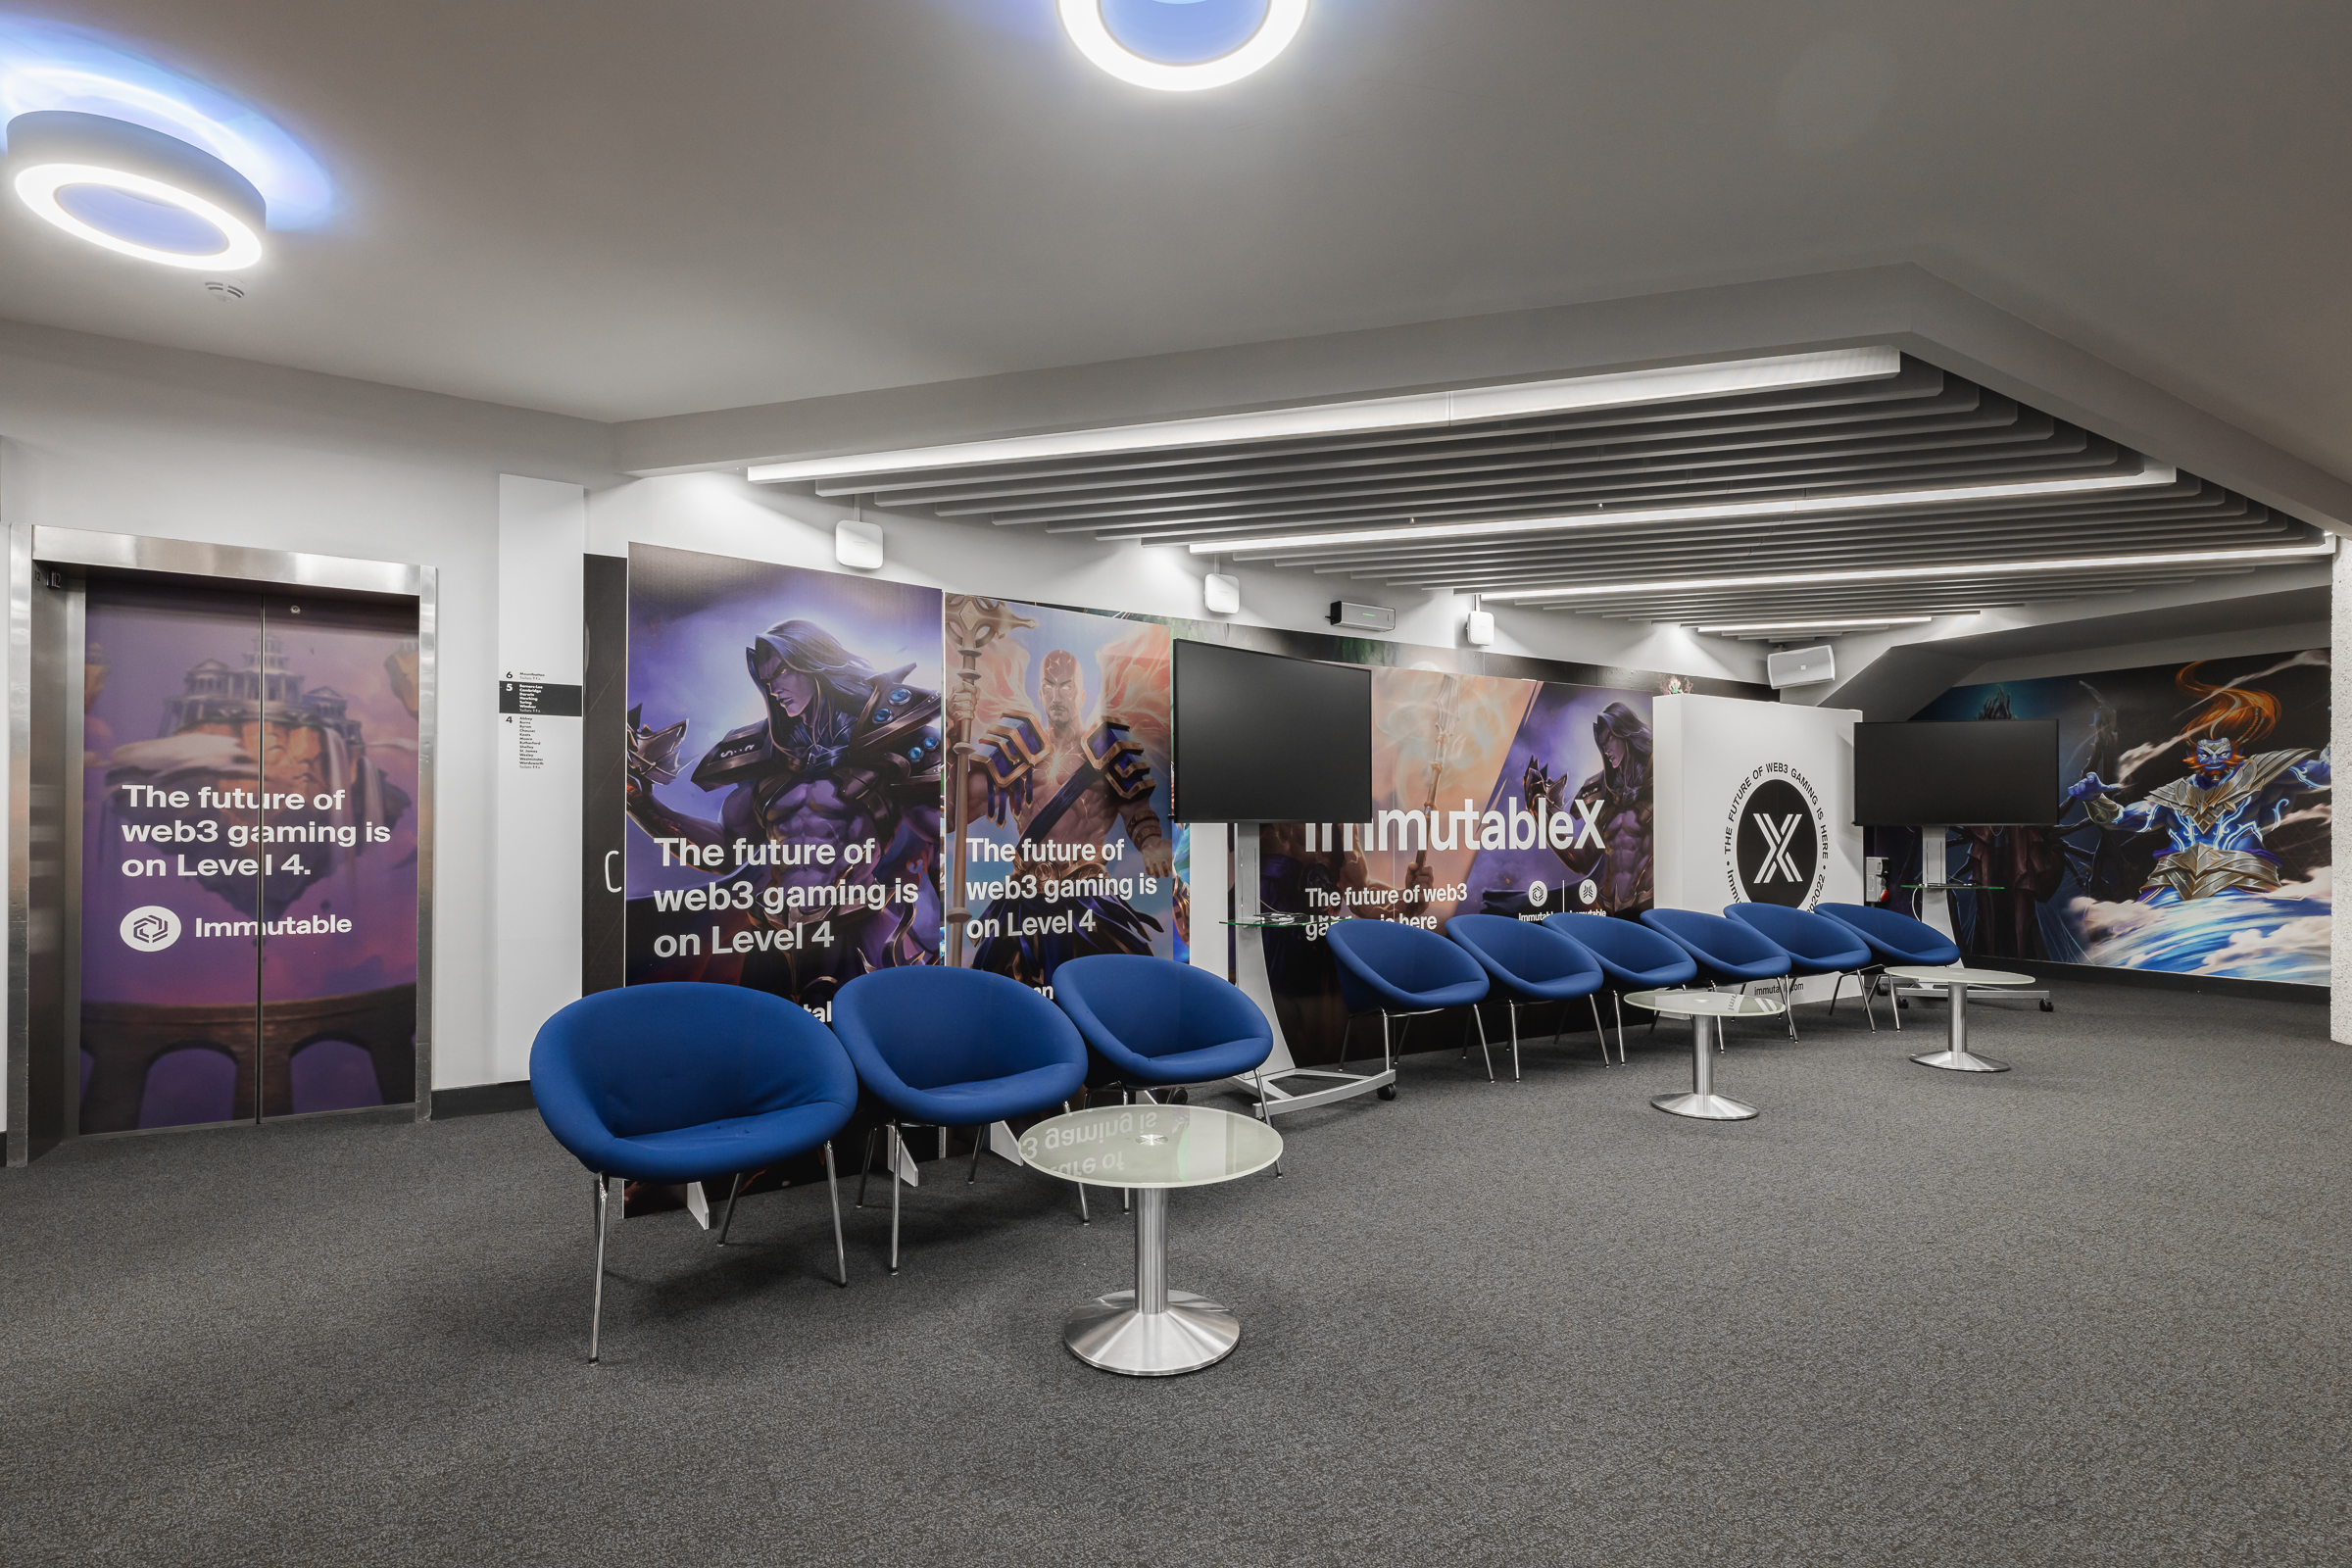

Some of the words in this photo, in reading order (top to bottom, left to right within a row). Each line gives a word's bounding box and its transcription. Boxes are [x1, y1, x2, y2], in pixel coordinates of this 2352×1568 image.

[506, 683, 514, 692] 5
[122, 784, 190, 808] The
[198, 786, 306, 809] future
[313, 789, 345, 810] of
[1729, 776, 1752, 822] FUTURE
[1752, 765, 1764, 780] OF
[1766, 762, 1788, 774] WEB3
[1790, 768, 1819, 806] GAMING
[1816, 808, 1825, 820] IS
[122, 819, 219, 843] web3
[227, 821, 357, 848] gaming
[366, 821, 391, 843] is
[654, 838, 725, 866] The
[733, 837, 836, 866] future
[843, 837, 876, 864] of
[966, 838, 1016, 862] The
[1021, 838, 1096, 862] future
[1102, 839, 1125, 860] of
[122, 858, 167, 877] on
[177, 855, 272, 876] Level
[280, 855, 312, 875] 4.
[653, 880, 755, 911] web3
[762, 878, 886, 915] gaming
[895, 878, 919, 904] is
[966, 874, 1037, 901] web3
[1044, 873, 1133, 904] gaming
[1139, 872, 1157, 895] is
[1305, 888, 1341, 907] The
[1345, 886, 1399, 906] future
[1403, 884, 1420, 904] of
[1423, 882, 1468, 903] web3
[196, 913, 353, 938] Immutable
[966, 918, 1000, 939] on
[1007, 909, 1072, 937] Level
[1078, 909, 1096, 932] 4
[1399, 913, 1437, 929] here
[1519, 911, 1553, 921] Immuta
[654, 932, 700, 958] on
[711, 921, 803, 955] Level
[811, 921, 835, 949] 4
[1754, 983, 1803, 996] immutalom
